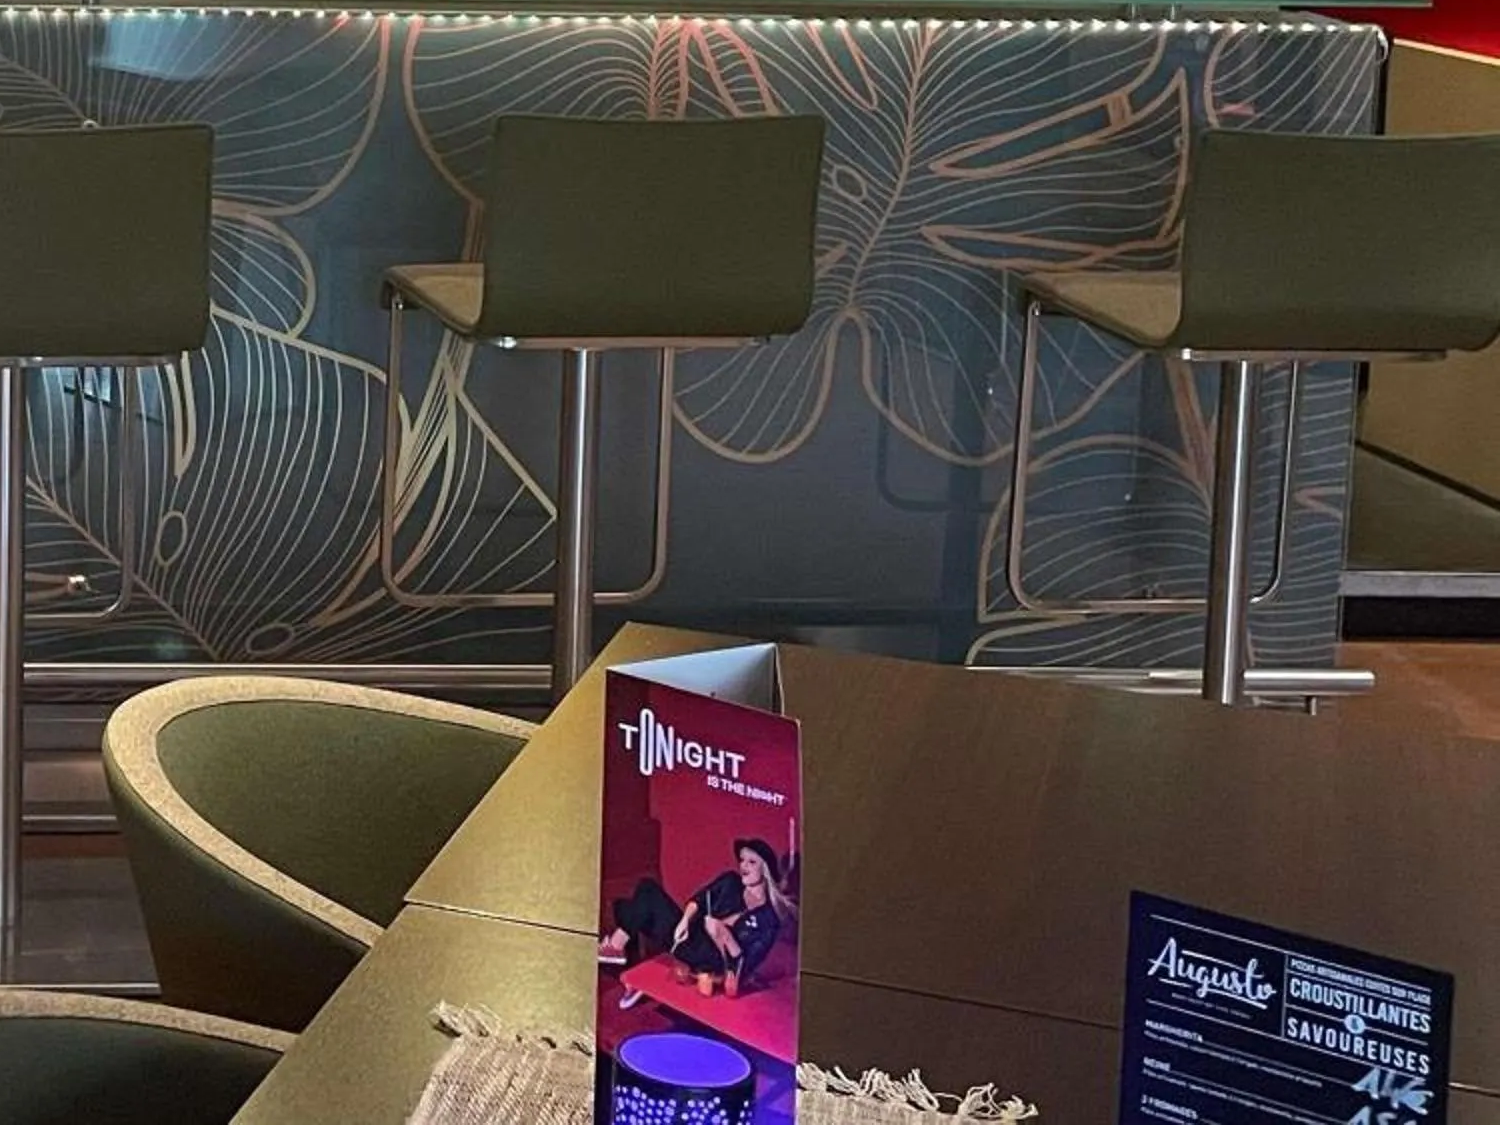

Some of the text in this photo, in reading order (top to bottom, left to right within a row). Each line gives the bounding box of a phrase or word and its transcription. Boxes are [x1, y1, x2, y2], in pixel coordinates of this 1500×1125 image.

[618, 708, 746, 776] TONIGHT
[707, 775, 787, 807] IS THE NIGHT
[1147, 937, 1277, 1000] Augusto
[1289, 978, 1431, 1034] CROUSTILLANTES
[1286, 1016, 1431, 1075] SAVOUREUSES
